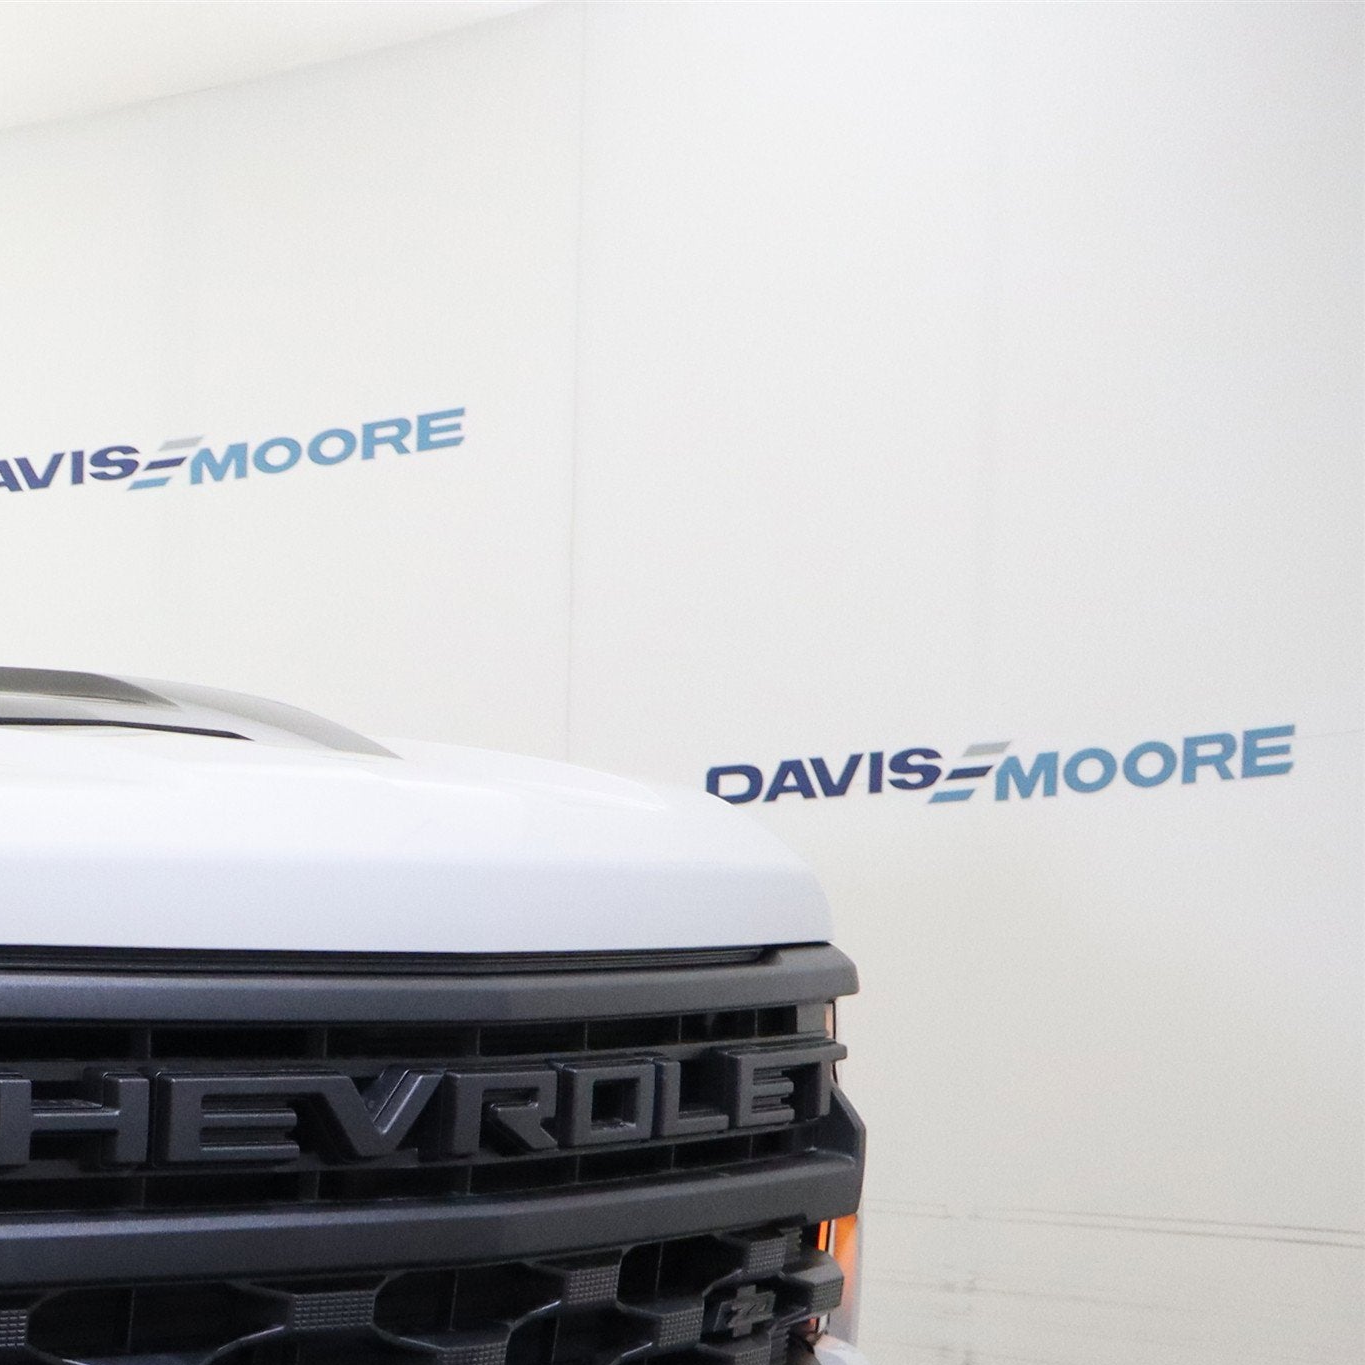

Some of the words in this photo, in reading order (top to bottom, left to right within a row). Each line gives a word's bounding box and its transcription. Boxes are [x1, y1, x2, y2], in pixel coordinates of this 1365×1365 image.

[189, 406, 465, 484] MOORE
[706, 748, 942, 804] DAVIS
[995, 725, 1295, 801] MOORE
